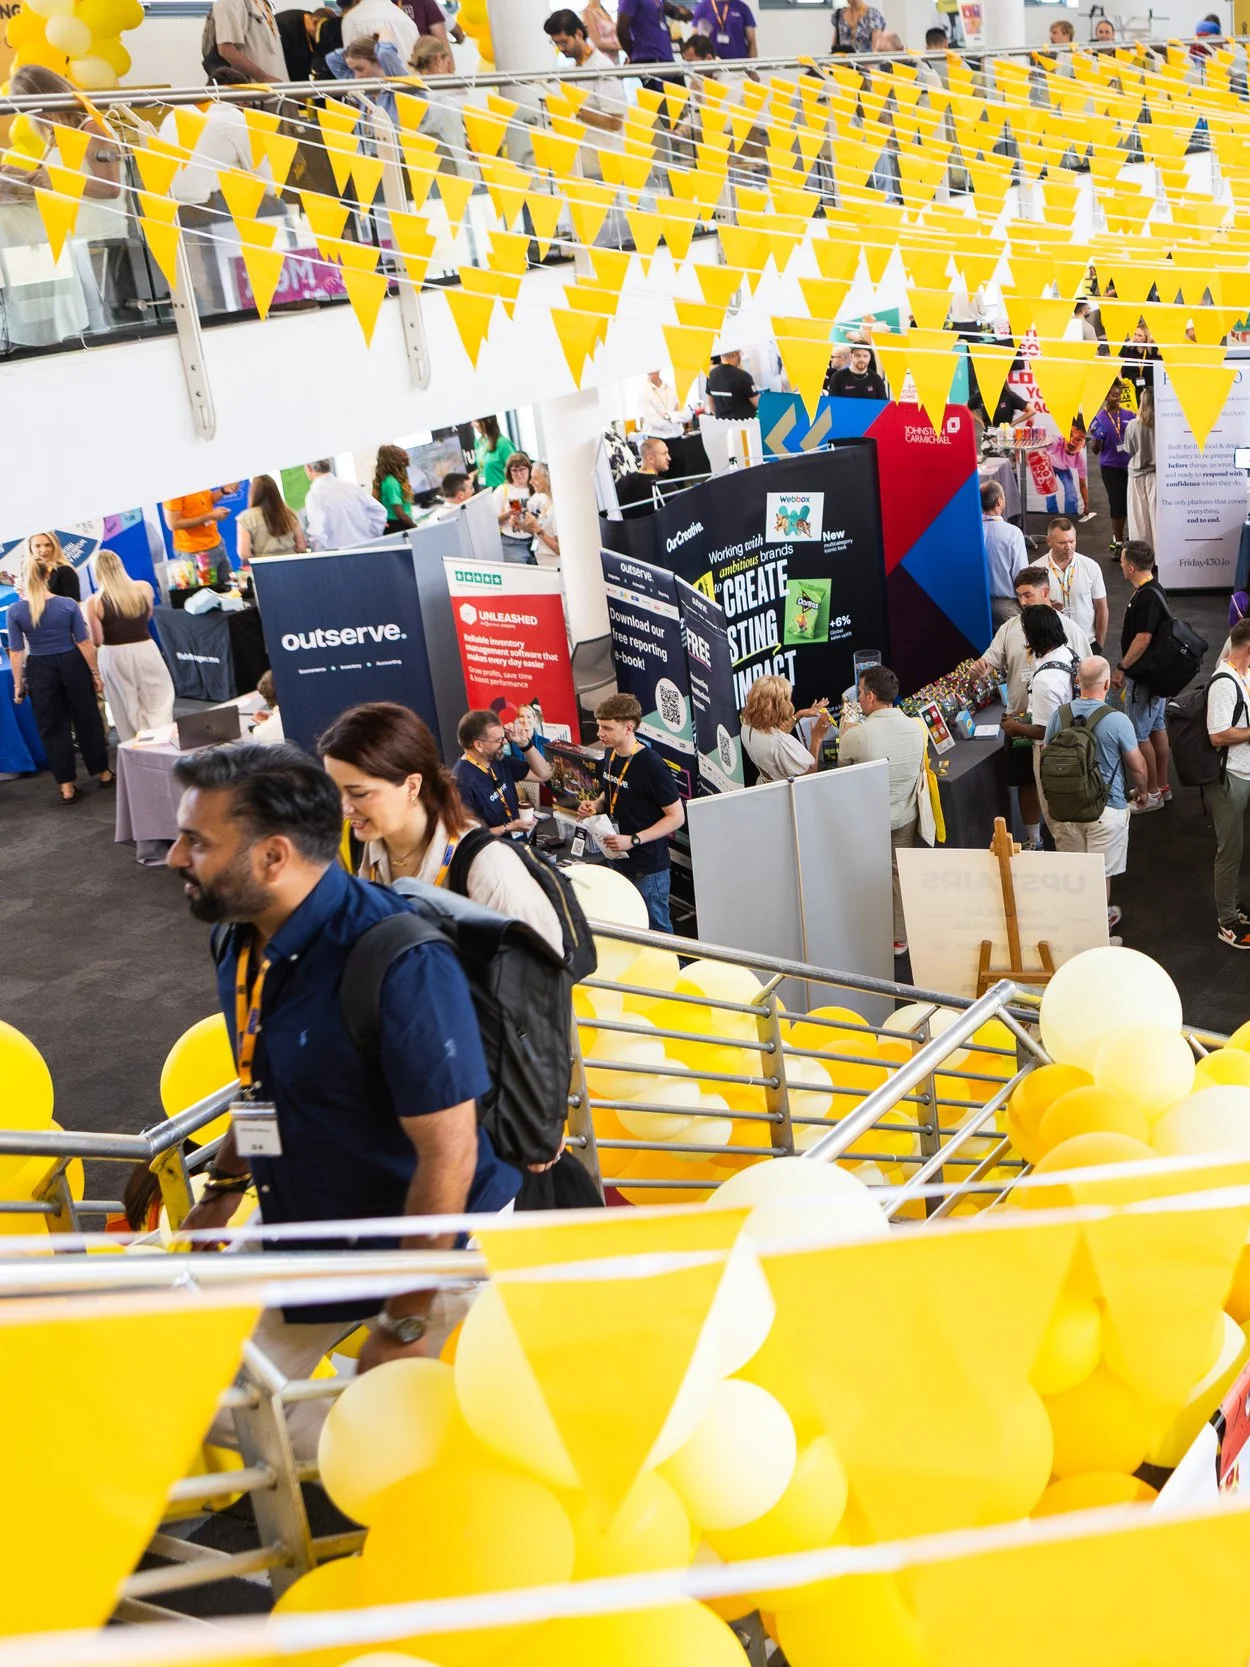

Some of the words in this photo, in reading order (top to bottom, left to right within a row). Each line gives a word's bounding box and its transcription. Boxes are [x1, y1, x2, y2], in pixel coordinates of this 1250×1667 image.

[904, 434, 952, 445] CARMICHAEL
[1169, 453, 1193, 461] industry
[1177, 471, 1194, 479] ready
[1203, 470, 1228, 478] respond
[1166, 480, 1200, 488] confidence
[779, 495, 811, 504] Webbox
[1174, 499, 1186, 507] only
[1188, 498, 1214, 507] platform
[666, 521, 704, 553] OurCreative.
[823, 530, 845, 542] New
[708, 543, 743, 565] Working
[744, 533, 764, 552] with
[719, 554, 759, 578] ambitious
[760, 543, 794, 563] brands
[1179, 557, 1231, 569] Friday430.io
[620, 562, 655, 582] outserve.
[722, 558, 791, 618] CREATE
[797, 596, 819, 609] Doritos
[478, 610, 538, 626] UNLEASHED
[609, 607, 650, 633] Download
[651, 622, 665, 639] our
[829, 614, 852, 628] +6%
[281, 623, 407, 652] outserve.
[463, 633, 489, 645] Reliable
[489, 637, 525, 650] inventory
[612, 627, 628, 645] free
[629, 635, 668, 663] reporting
[465, 644, 509, 656] management
[510, 649, 542, 660] software
[542, 652, 559, 662] that
[686, 626, 712, 669] FREE
[466, 653, 487, 664] makes
[488, 656, 507, 668] every
[508, 657, 522, 669] day
[523, 660, 545, 670] easier
[614, 650, 646, 671] e-book!
[468, 665, 482, 675] Grow
[504, 671, 517, 680] save
[518, 672, 533, 681] time
[475, 674, 490, 684] boost
[490, 678, 529, 689] performance
